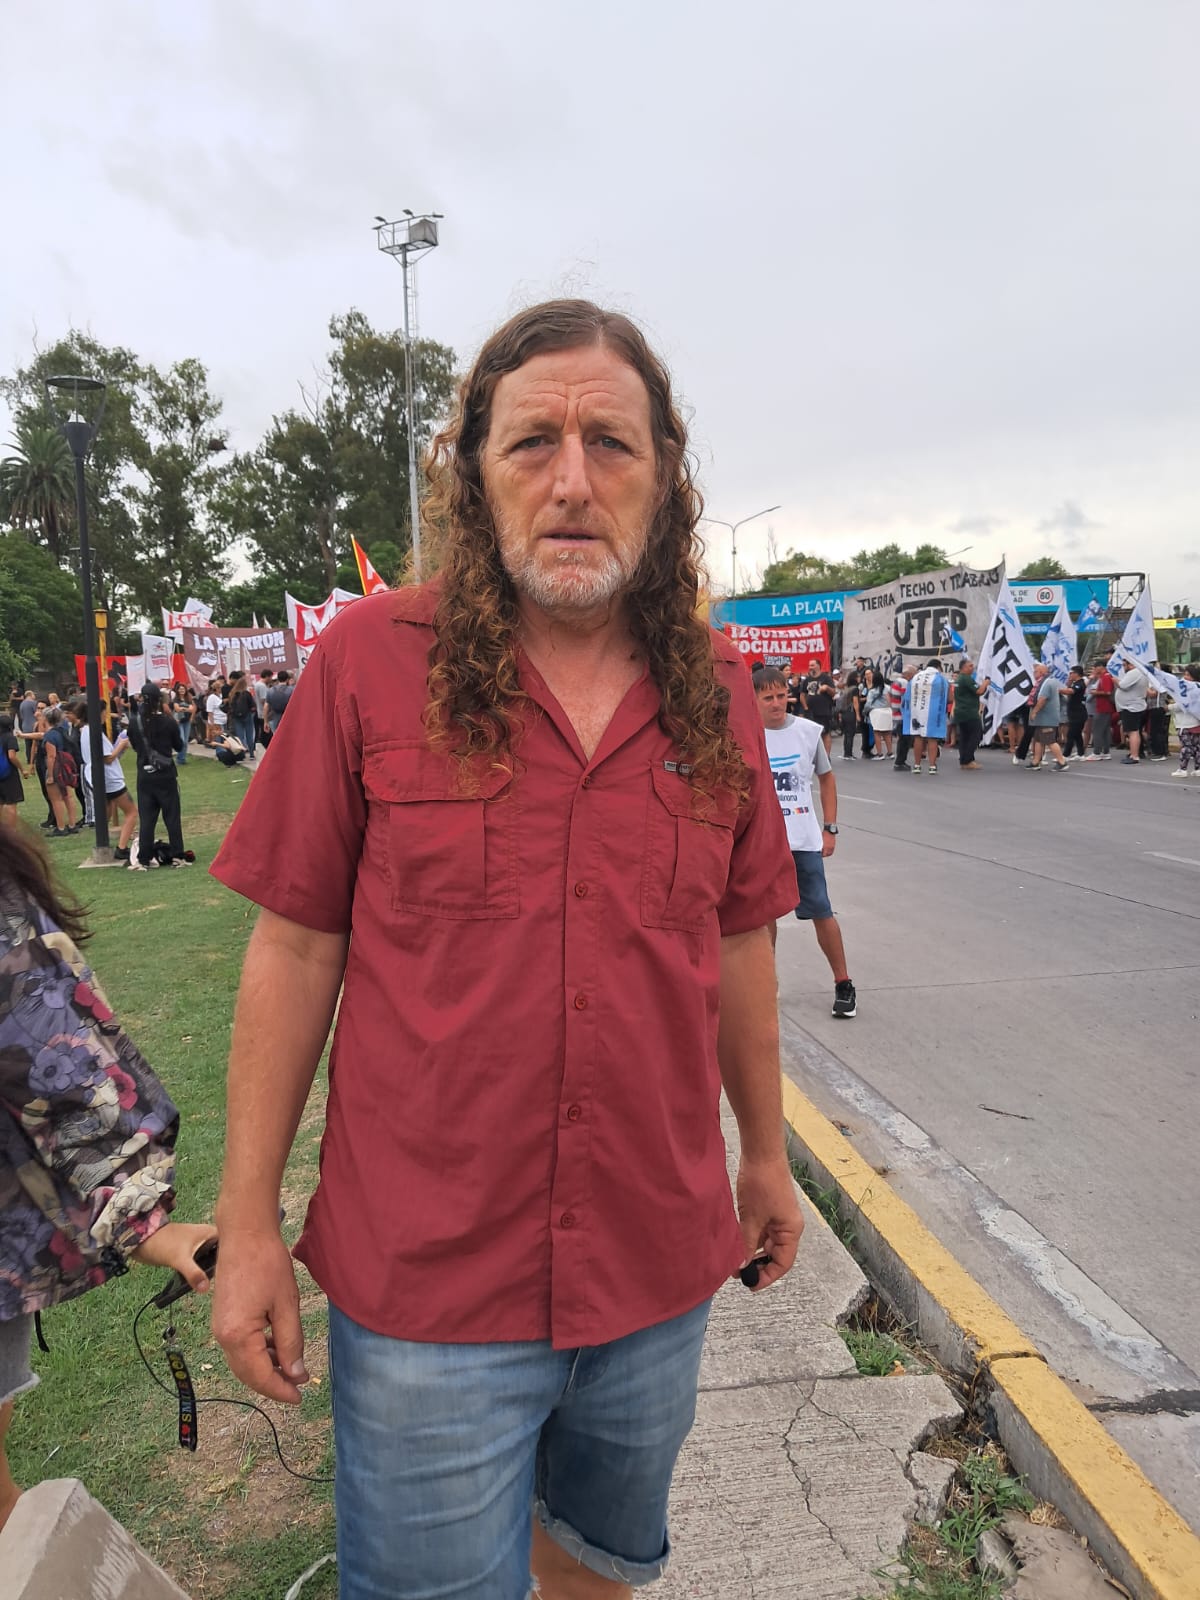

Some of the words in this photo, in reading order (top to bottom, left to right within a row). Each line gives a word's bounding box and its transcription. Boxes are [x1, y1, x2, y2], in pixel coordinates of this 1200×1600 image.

[858, 593, 896, 611] TIERRA
[900, 581, 935, 598] TECHO
[940, 580, 948, 592] Y
[950, 568, 999, 591] TRABAJO
[1040, 591, 1051, 600] 60
[772, 604, 791, 617] LA
[795, 599, 844, 616] PLATA
[731, 624, 822, 640] IZQUIERDA
[894, 608, 967, 646] UTEP
[193, 634, 215, 651] LA
[732, 638, 825, 654] OCIALISTA
